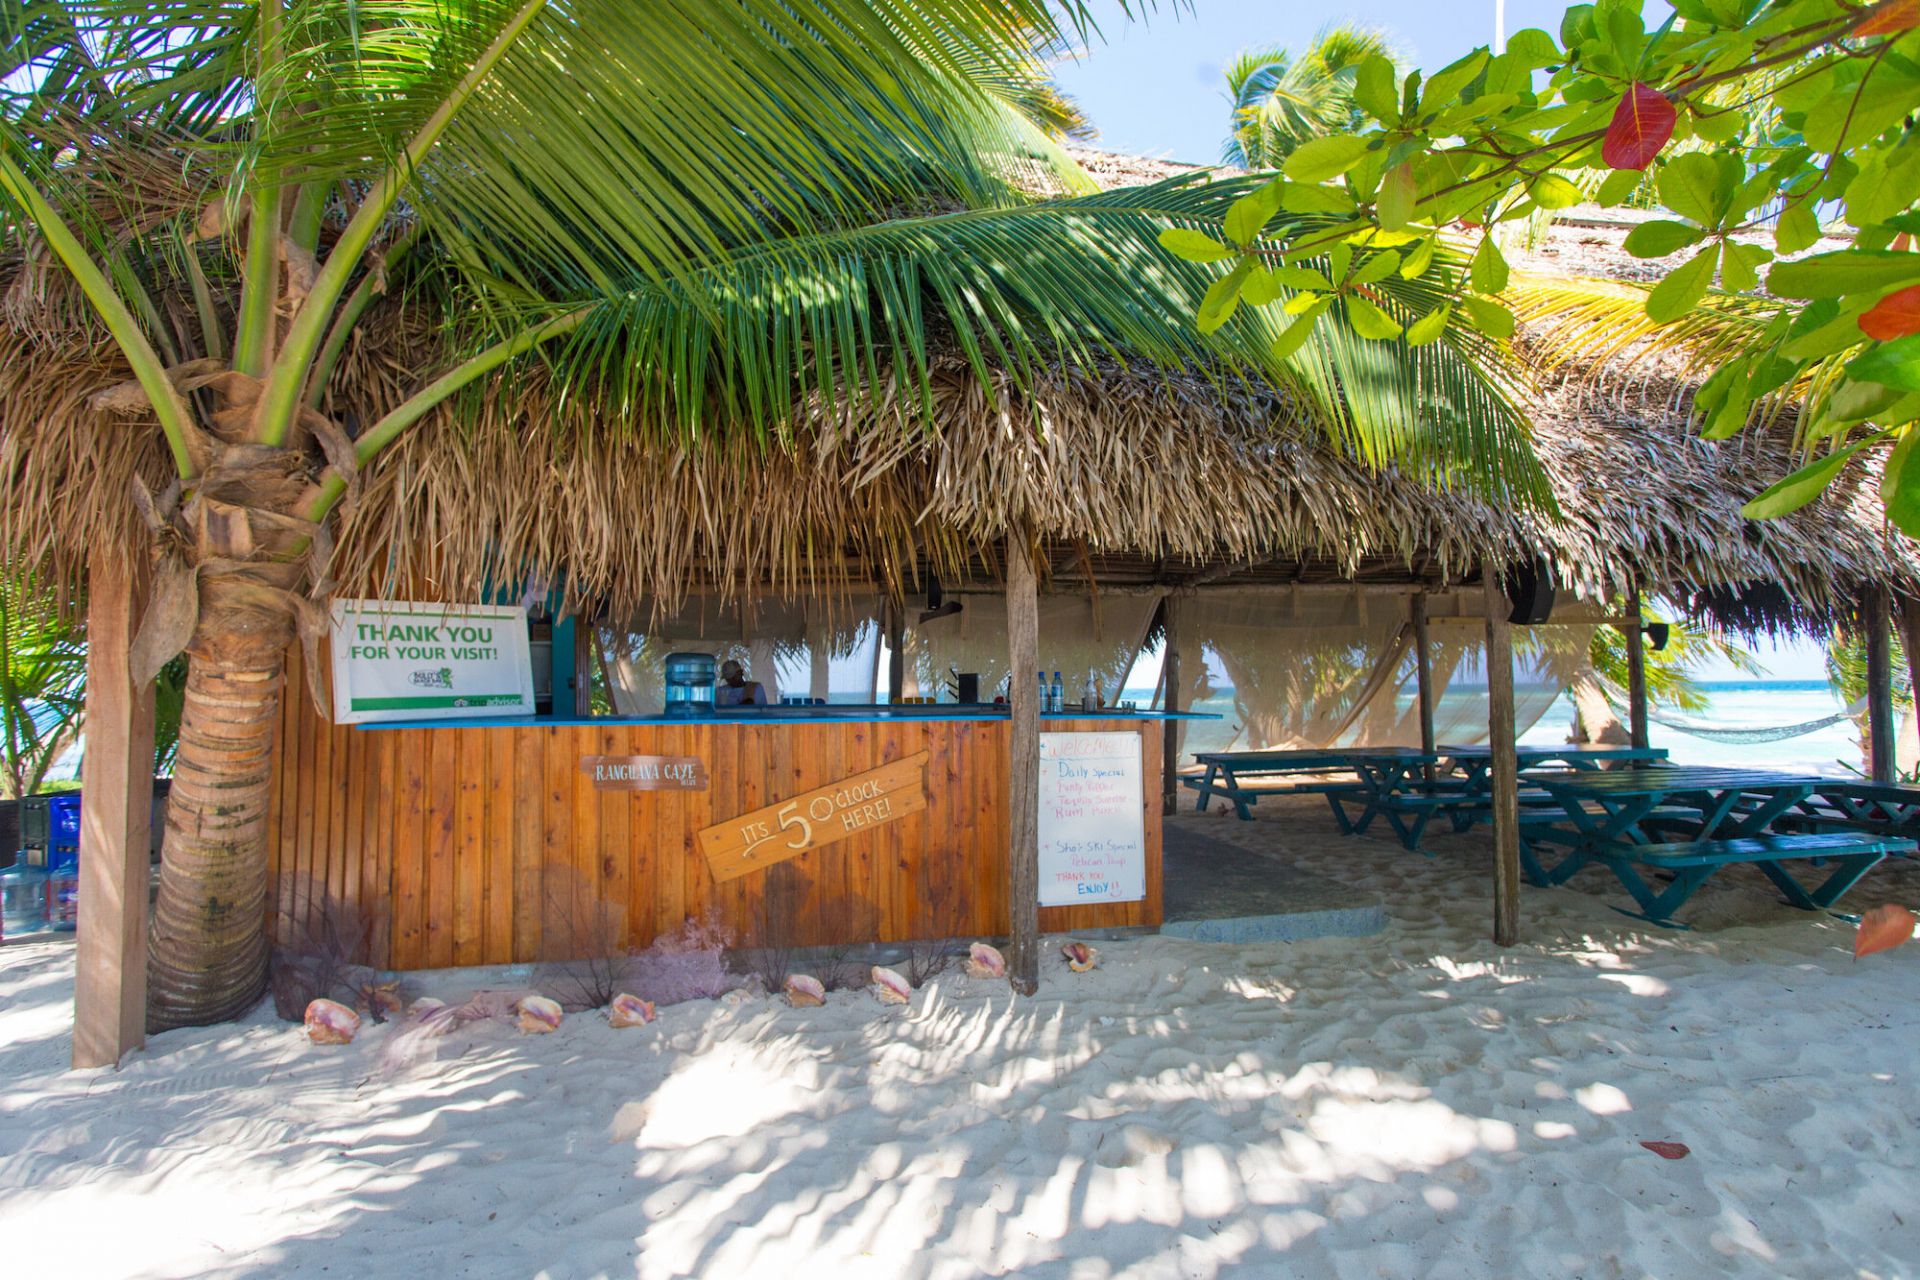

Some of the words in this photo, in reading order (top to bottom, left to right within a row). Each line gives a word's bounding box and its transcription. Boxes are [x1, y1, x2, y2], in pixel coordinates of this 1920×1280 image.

[357, 624, 440, 642] THANK
[446, 626, 493, 643] YOU
[351, 646, 390, 660] FOR
[395, 646, 446, 660] YOUR
[451, 647, 498, 660] VISIT!
[596, 763, 659, 781] RANGUANA
[1059, 761, 1088, 780] Daily
[741, 821, 769, 845] IT'S
[778, 800, 812, 849] 5
[809, 779, 884, 822] O'CLOCK
[841, 797, 893, 831] HERE!
[1056, 872, 1084, 882] THANK
[1089, 872, 1104, 880] YOU
[1078, 882, 1109, 894] ENJOY
